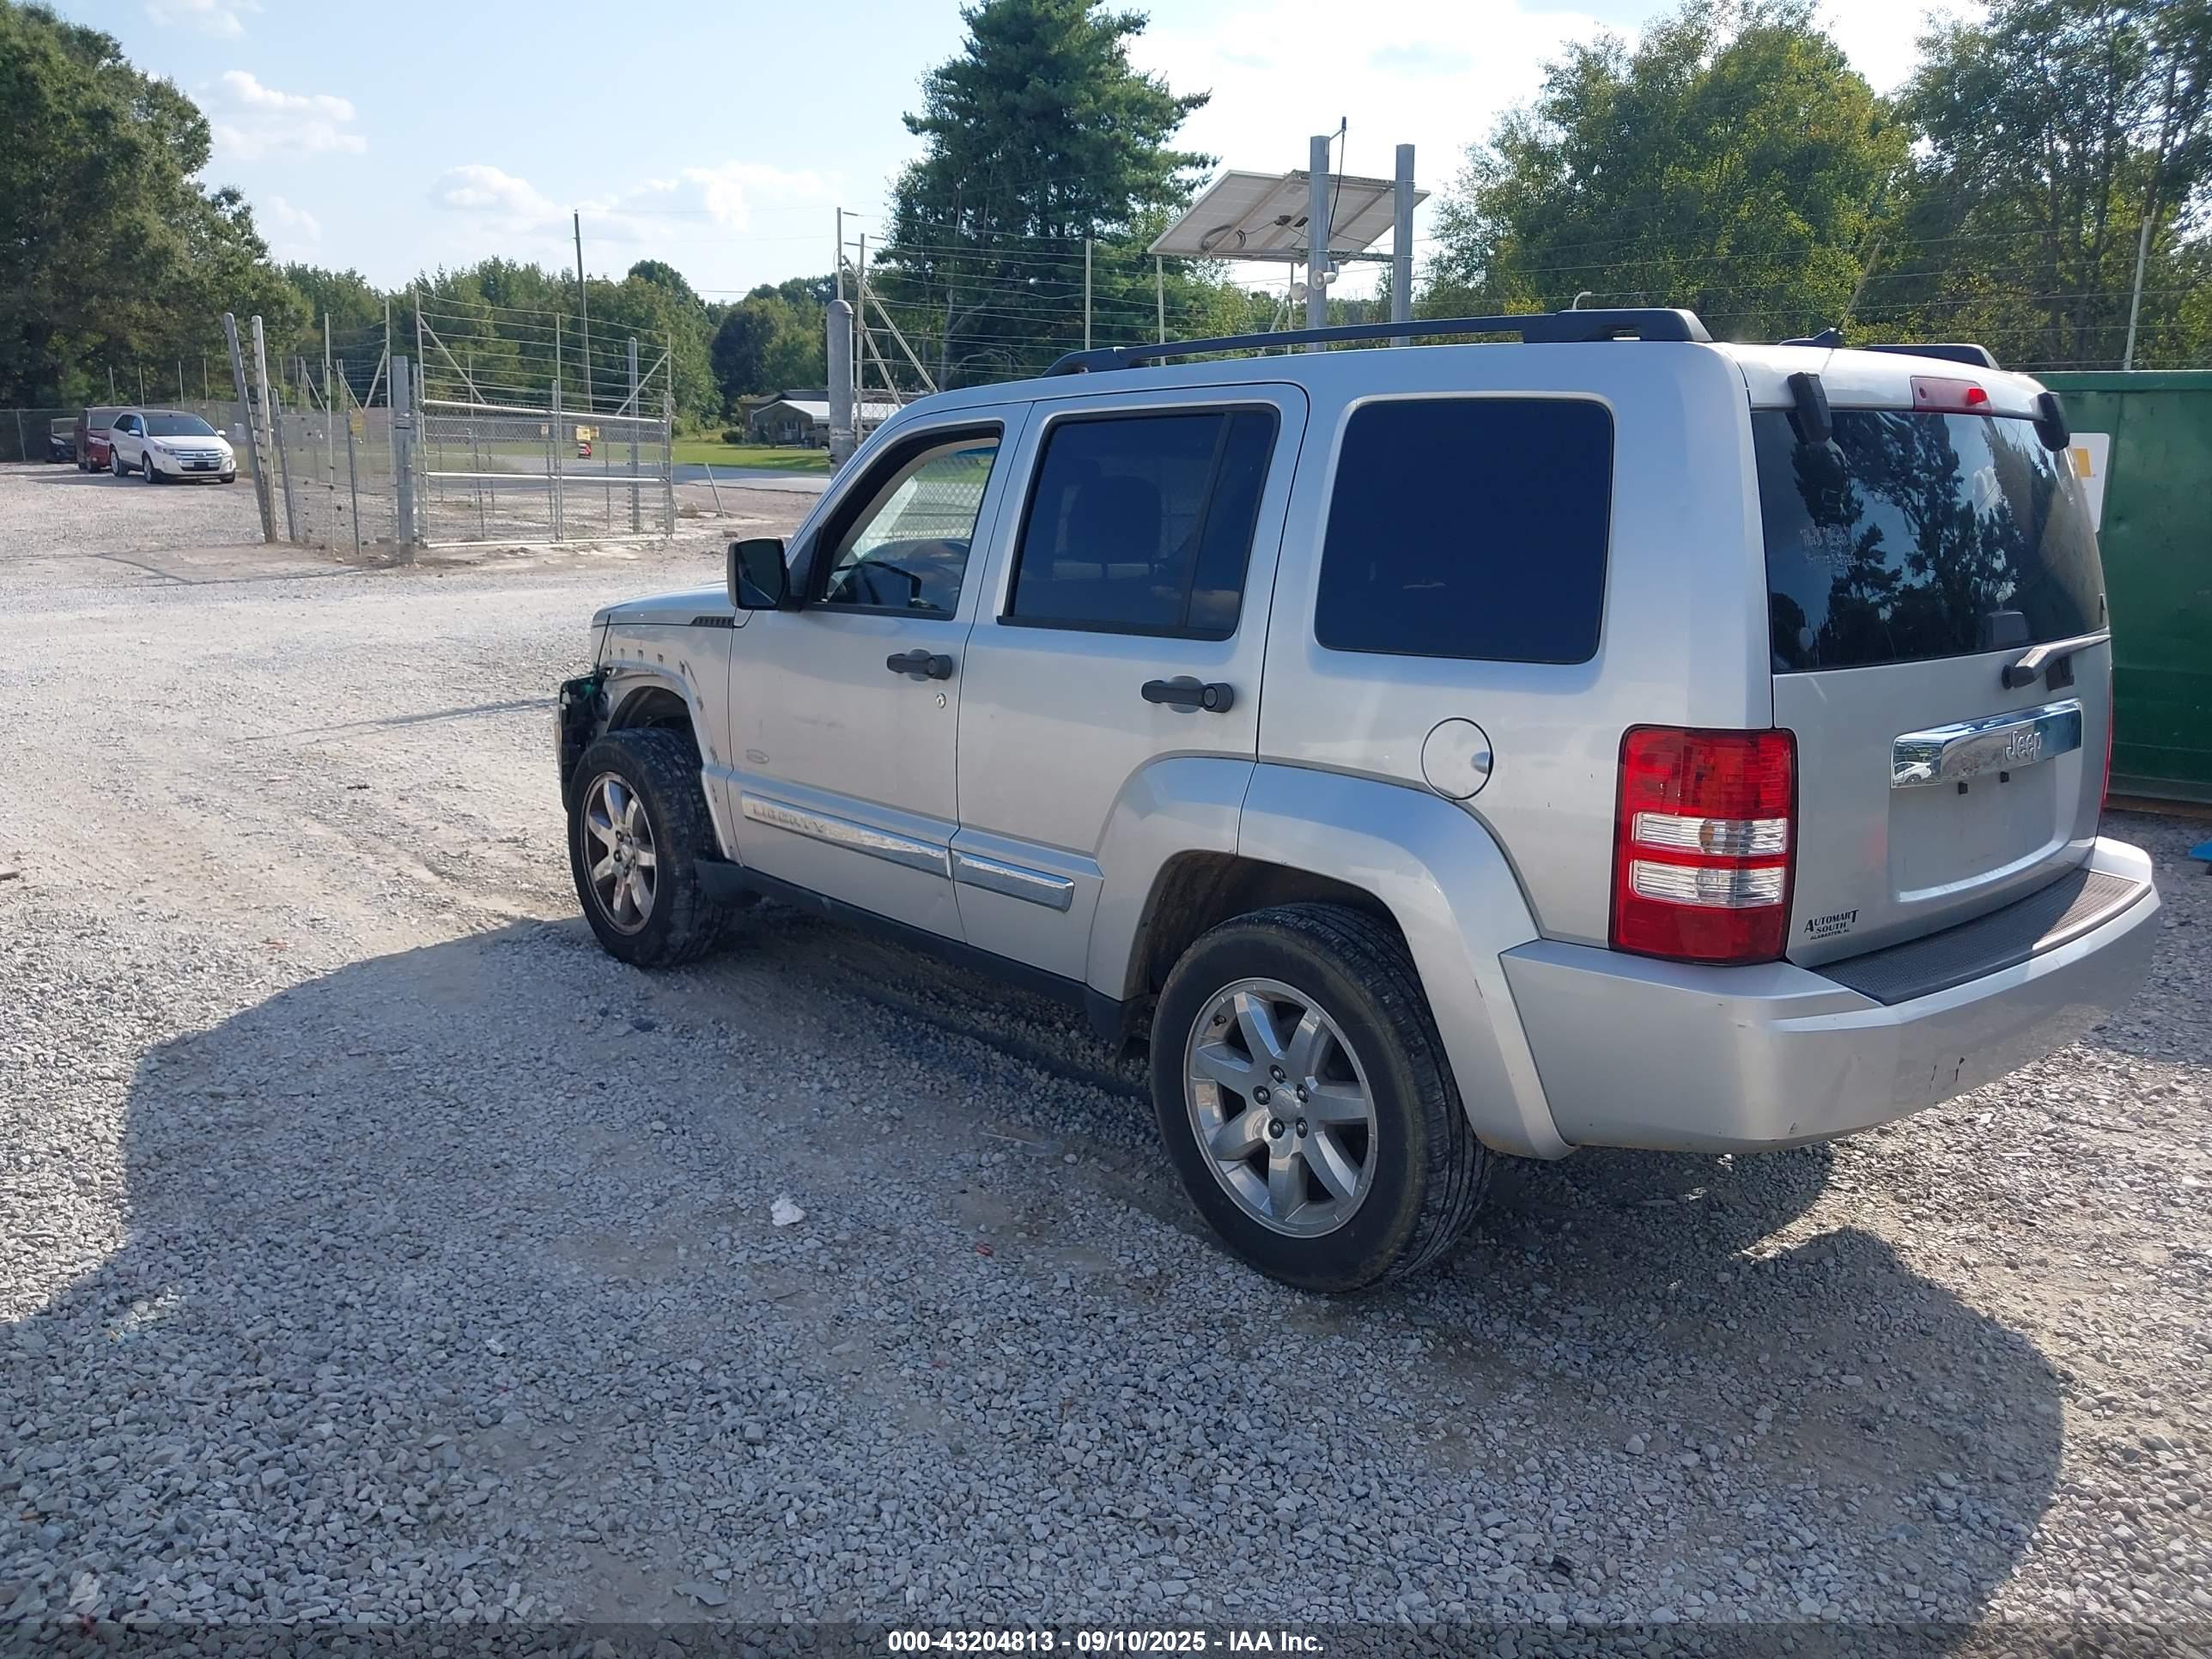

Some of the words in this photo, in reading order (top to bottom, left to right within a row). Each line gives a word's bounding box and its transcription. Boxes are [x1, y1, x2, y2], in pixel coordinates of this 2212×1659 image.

[2003, 731, 2041, 762] Jeep
[752, 804, 825, 833] LIBERTY
[1803, 909, 1860, 933] AUTOMART
[1815, 921, 1847, 933] SOUTH
